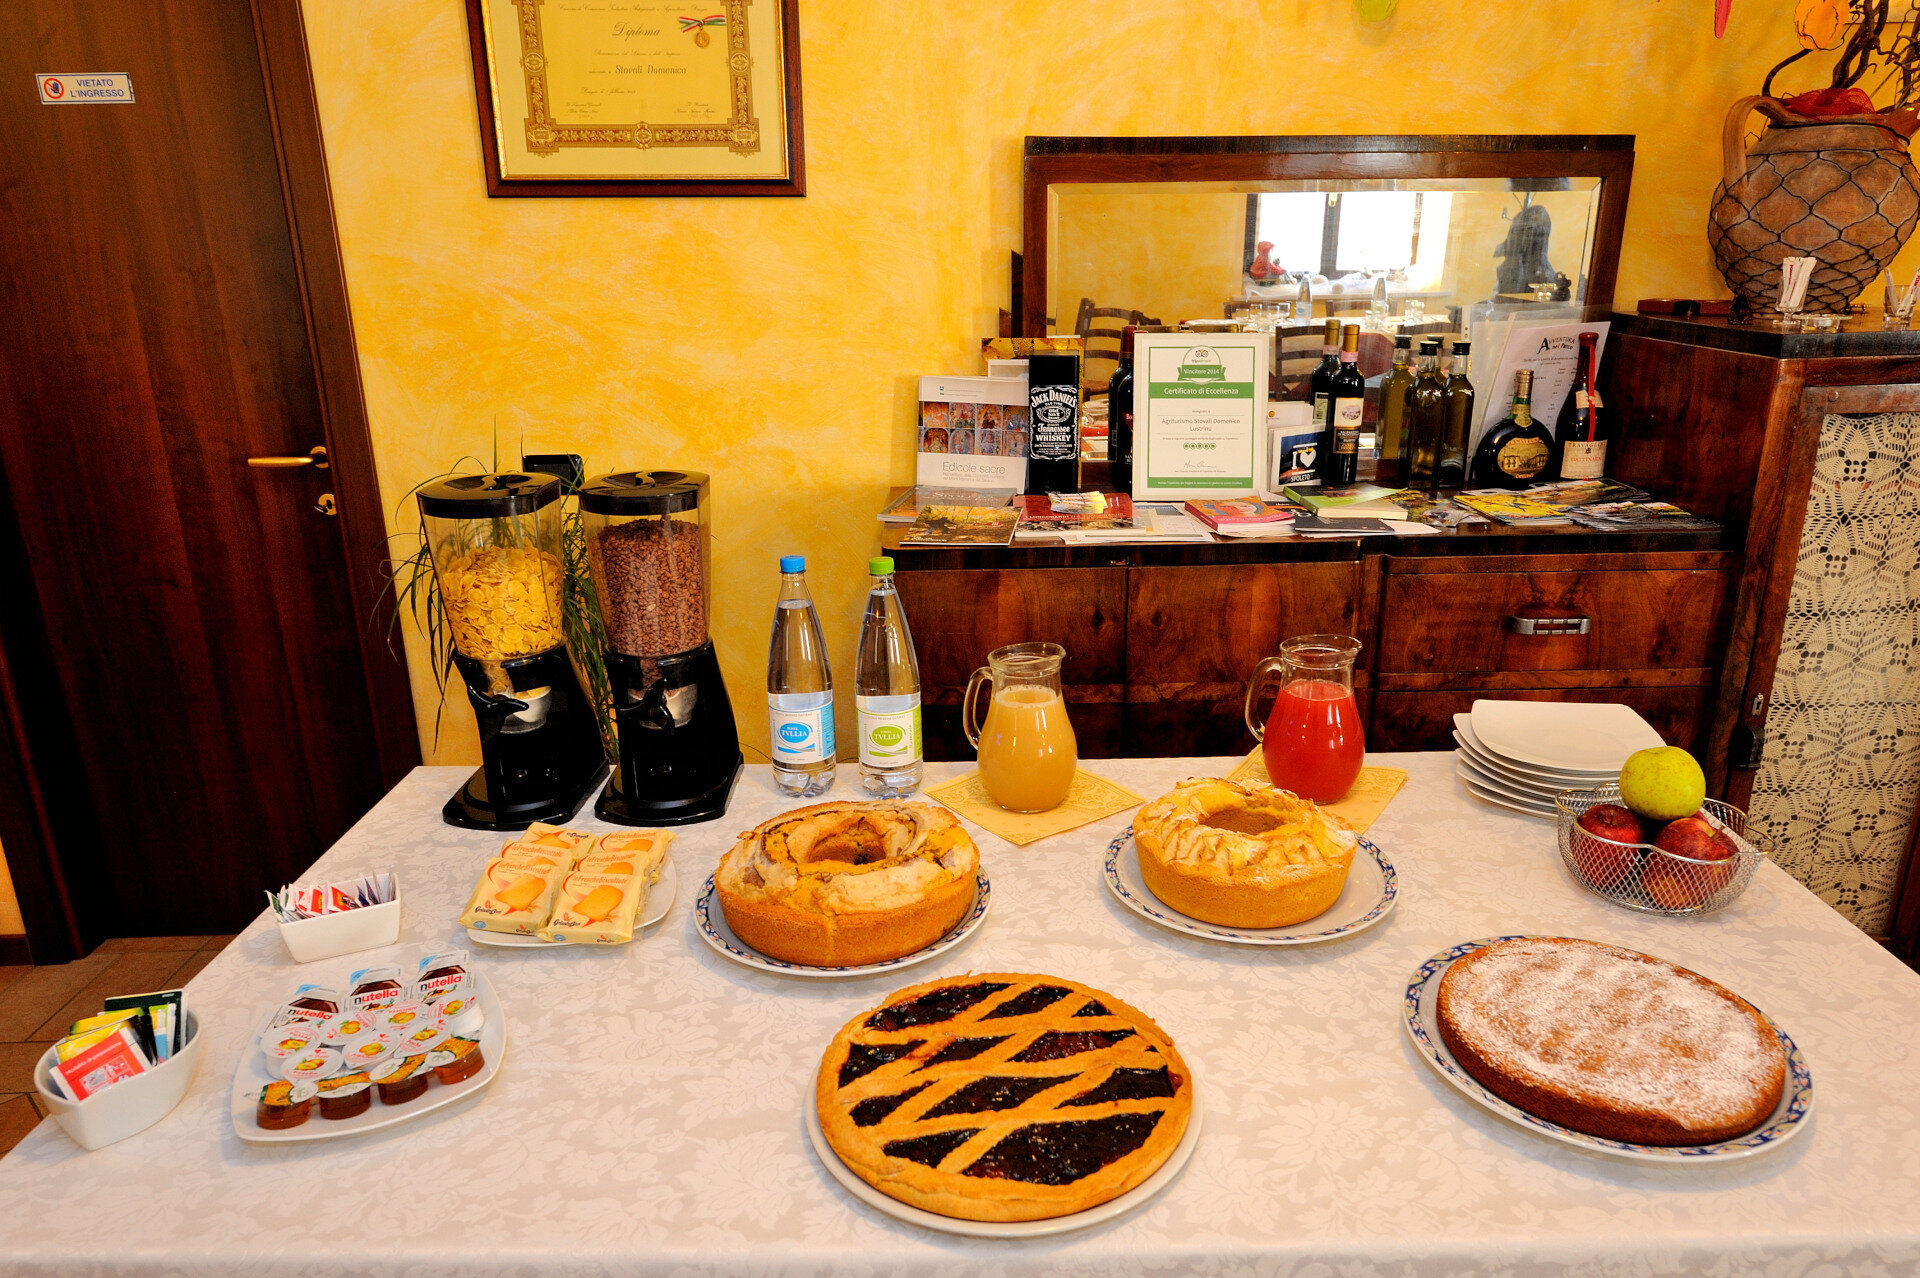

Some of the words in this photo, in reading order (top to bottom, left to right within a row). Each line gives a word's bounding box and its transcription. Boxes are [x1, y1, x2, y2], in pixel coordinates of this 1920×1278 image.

[611, 21, 661, 42] Diploma
[647, 65, 687, 75] Domenico
[76, 78, 114, 88] VIETATO
[70, 89, 125, 98] L'INGRESSO
[1163, 387, 1197, 395] Certificato
[1199, 387, 1205, 395] di
[1031, 392, 1049, 408] JACK
[1048, 389, 1077, 408] DANIEL'S
[1161, 418, 1193, 426] Agriturismo
[1037, 423, 1071, 433] Tennessee
[1035, 434, 1072, 442] WHISKEY
[942, 461, 977, 473] Edicole
[979, 465, 1006, 475] sacre
[1291, 473, 1311, 482] SPOLETO
[420, 974, 463, 992] nutella
[353, 988, 399, 1005] nutella
[287, 1008, 333, 1021] nutella
